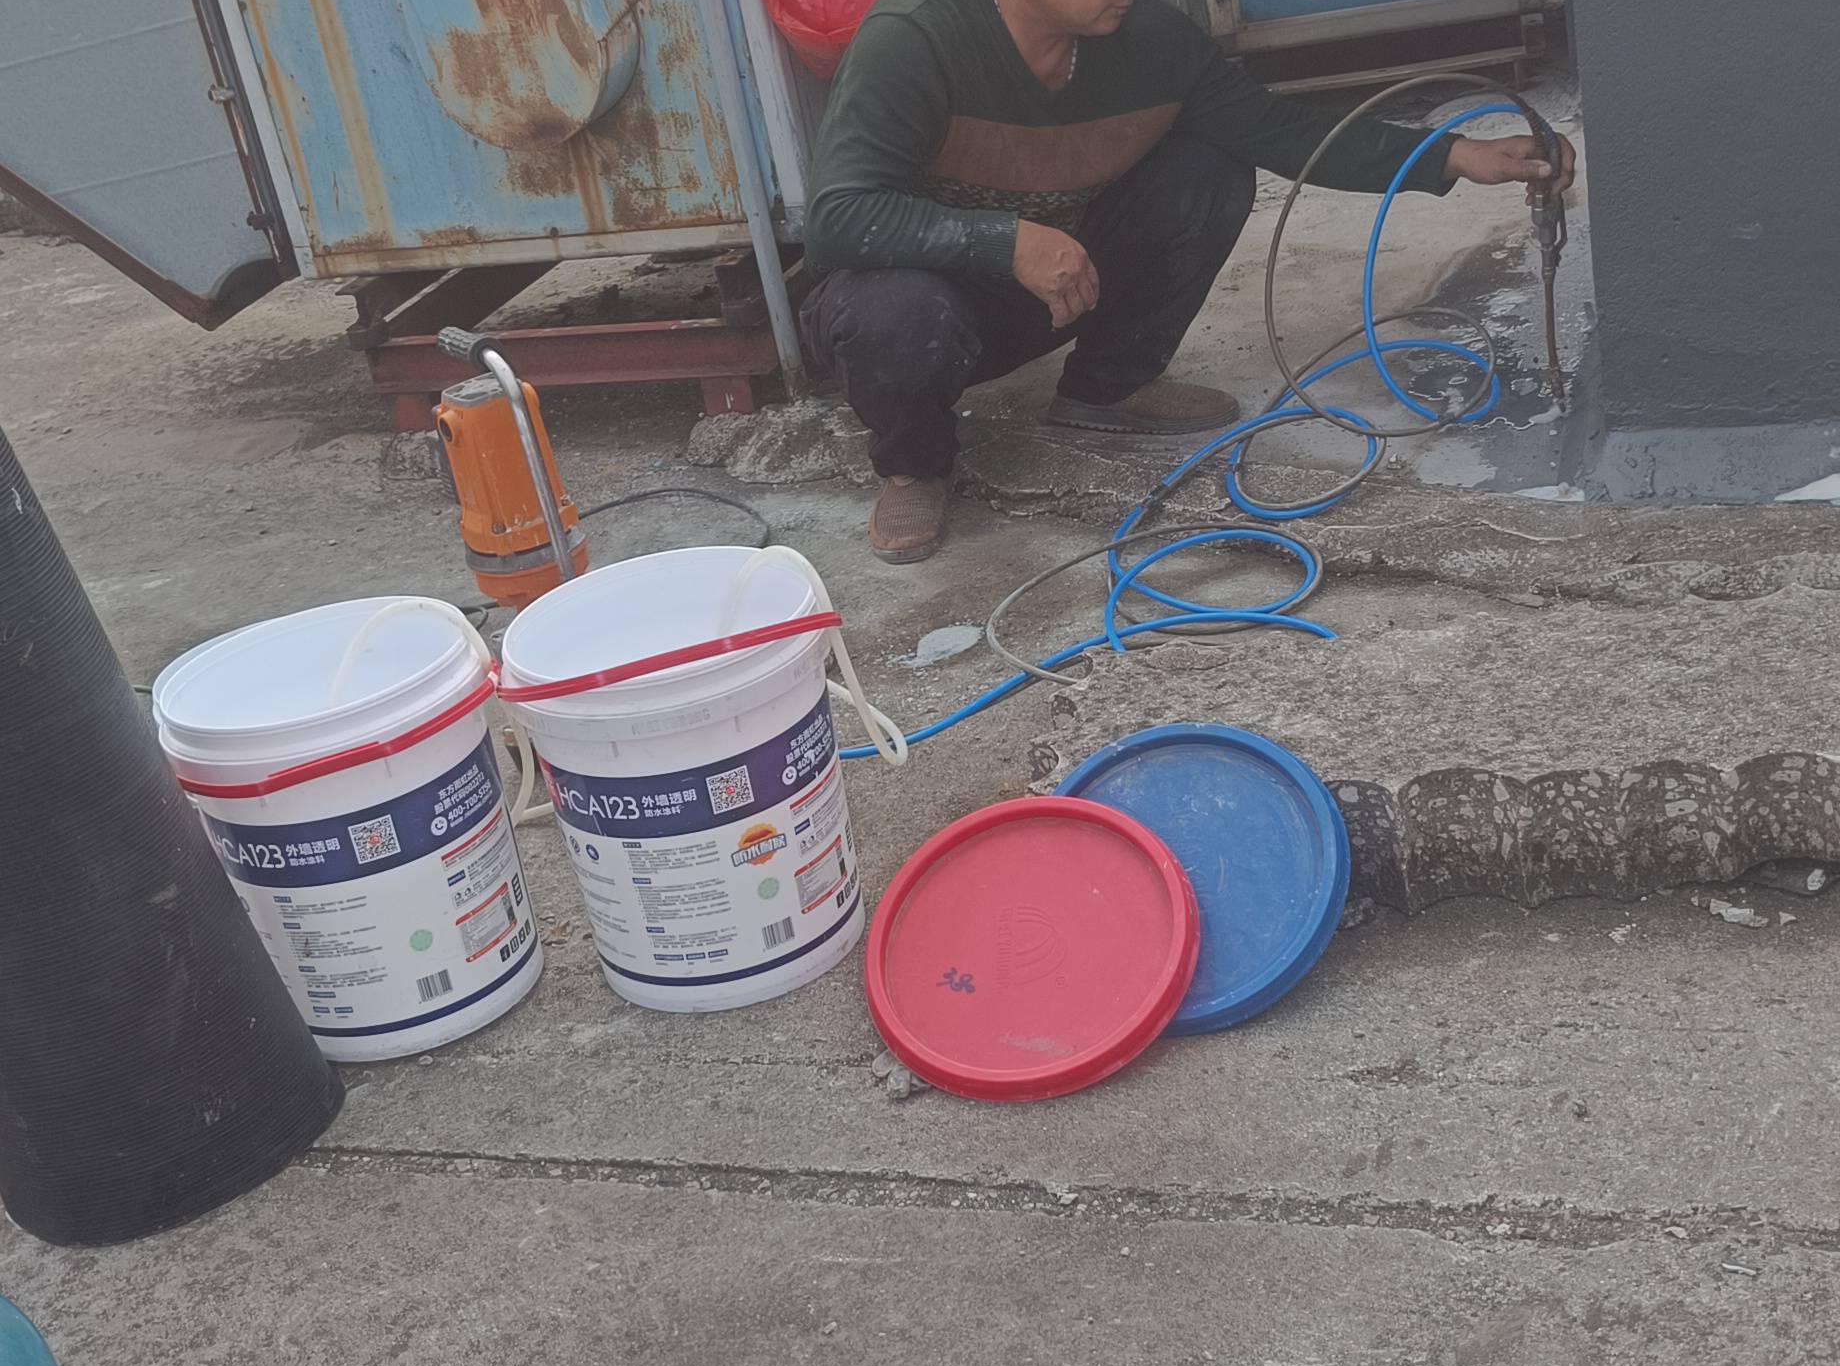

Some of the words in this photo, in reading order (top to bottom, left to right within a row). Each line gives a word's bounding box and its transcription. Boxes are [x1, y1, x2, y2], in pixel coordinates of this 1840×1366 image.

[556, 782, 640, 820] HCA123
[641, 788, 697, 808] 外墙透明
[285, 837, 341, 857] 外墙透明
